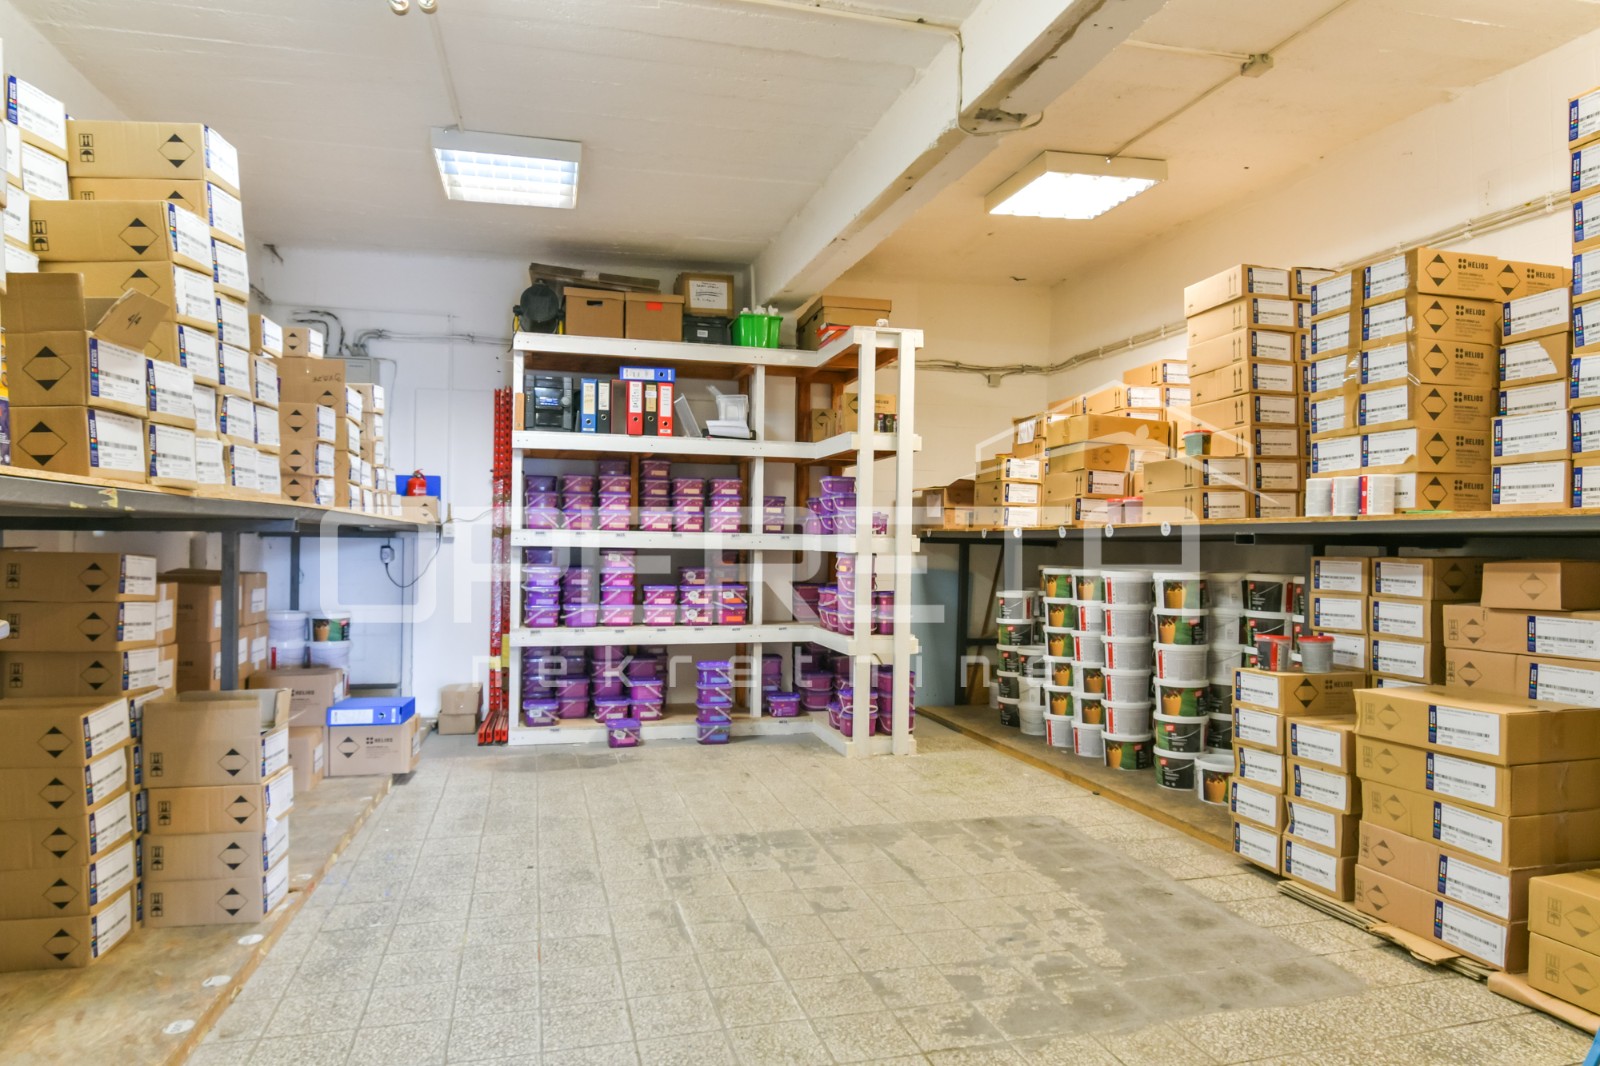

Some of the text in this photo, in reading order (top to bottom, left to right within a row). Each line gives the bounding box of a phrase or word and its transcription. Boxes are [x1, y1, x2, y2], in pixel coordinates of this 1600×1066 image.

[1467, 261, 1489, 270] HELIOS
[1535, 271, 1556, 279] HELIOS
[1465, 307, 1486, 316] HELIOS
[1464, 350, 1484, 359] HELIOS
[1463, 394, 1484, 402] HELIOS
[1465, 438, 1485, 446] HELIOS
[1463, 482, 1484, 490] HELIOS
[1333, 680, 1353, 688] HELIOS
